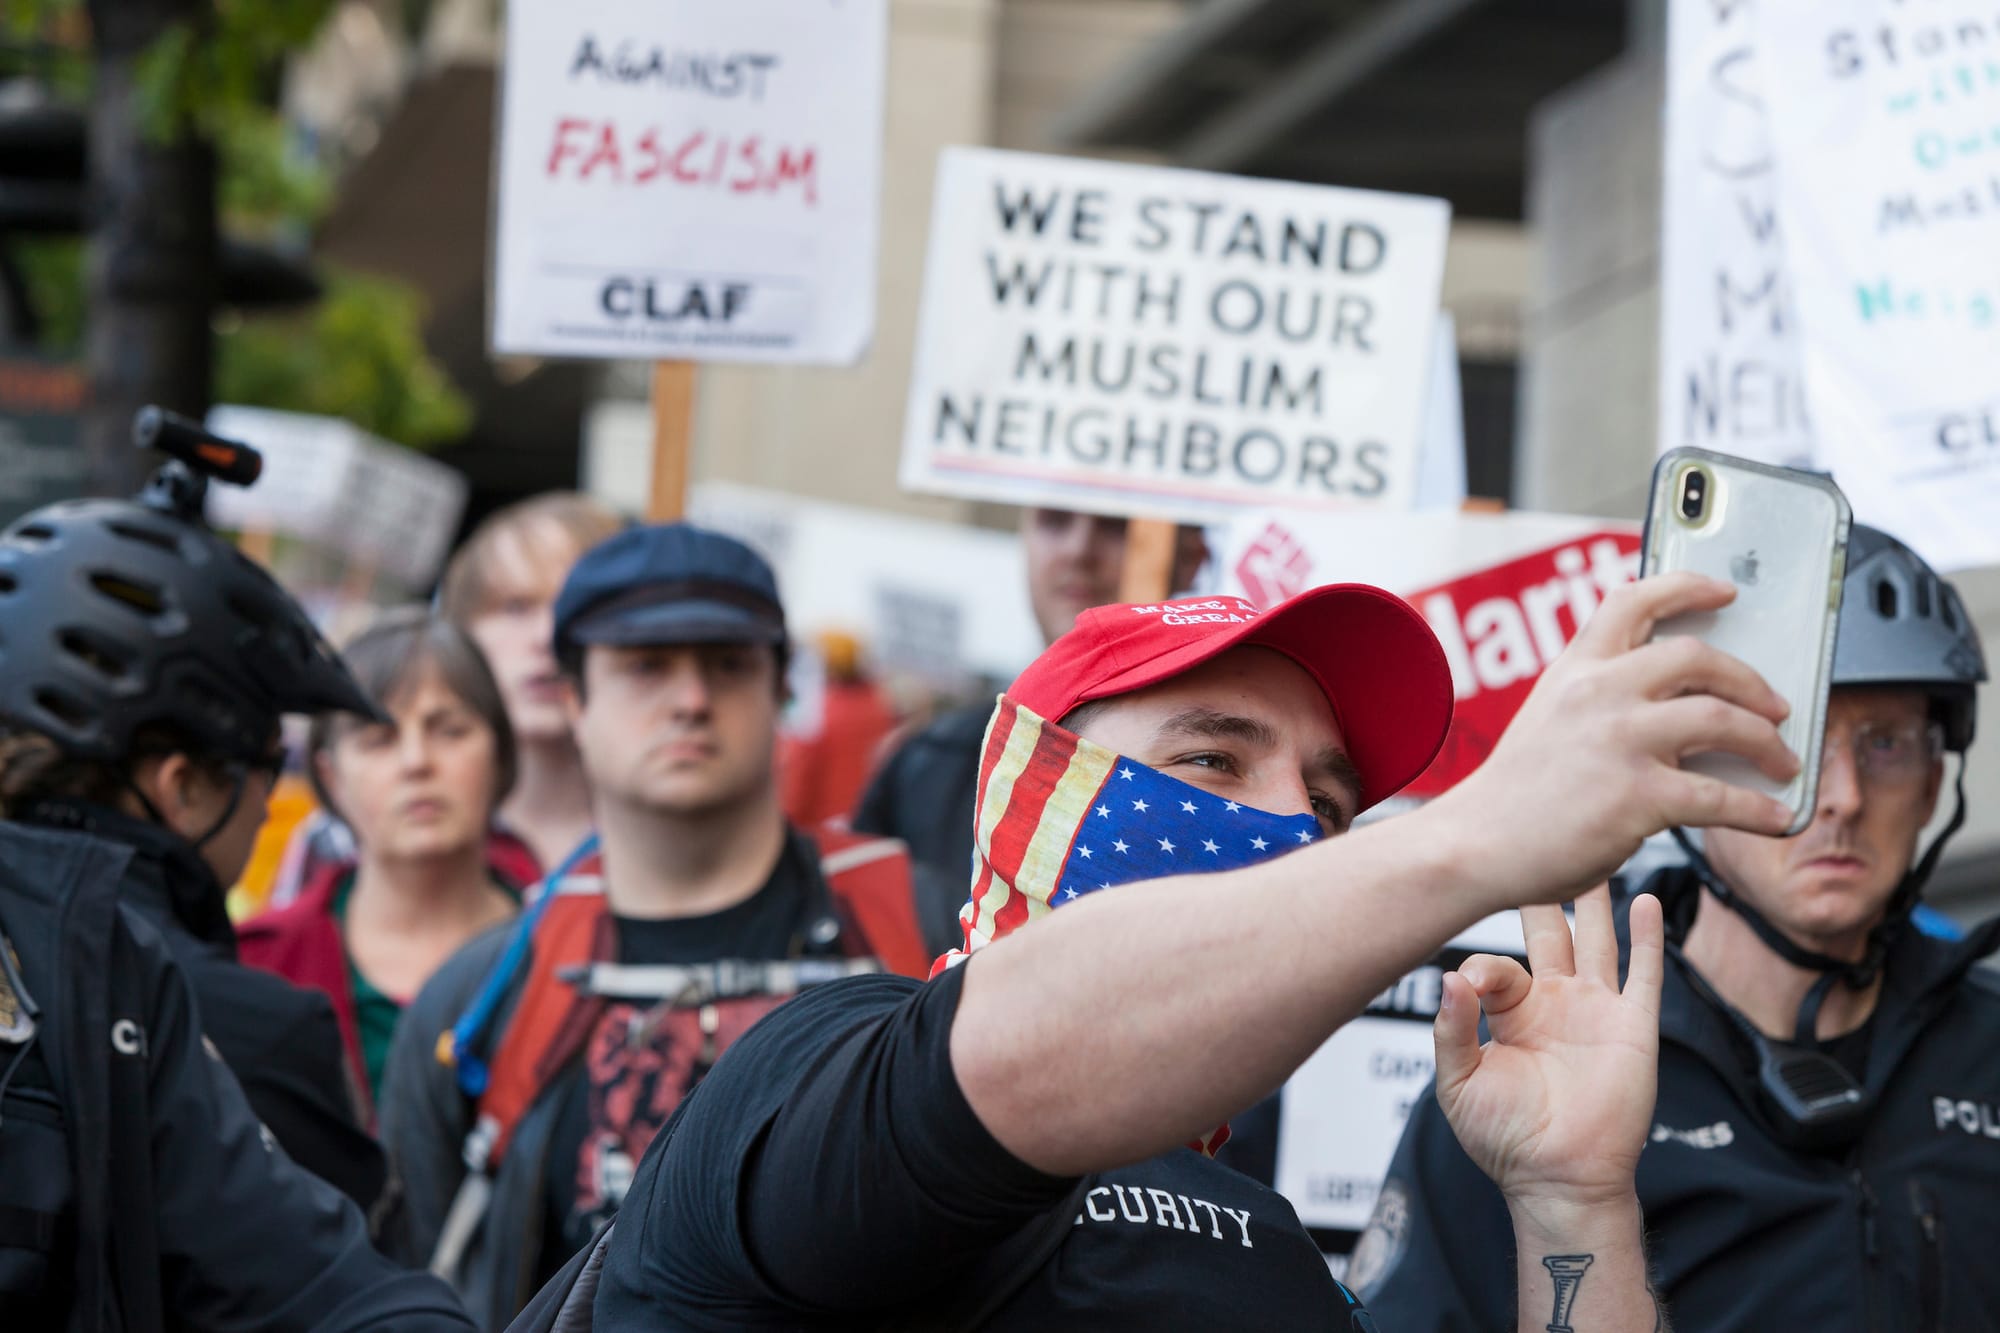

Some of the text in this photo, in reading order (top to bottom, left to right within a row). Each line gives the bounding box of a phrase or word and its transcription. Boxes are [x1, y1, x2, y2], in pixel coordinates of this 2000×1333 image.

[570, 35, 778, 98] AGAINST
[546, 117, 817, 205] FASCISM
[992, 181, 1388, 274] WE STAND
[599, 278, 752, 322] CLAF
[984, 251, 1377, 352] WITH OUR
[1013, 333, 1327, 416] MUSLIM
[933, 393, 1392, 499] NEIGHBORS
[1131, 600, 1227, 614] MAKE
[1162, 613, 1257, 625] GREA
[1074, 1184, 1253, 1248] CURITY
